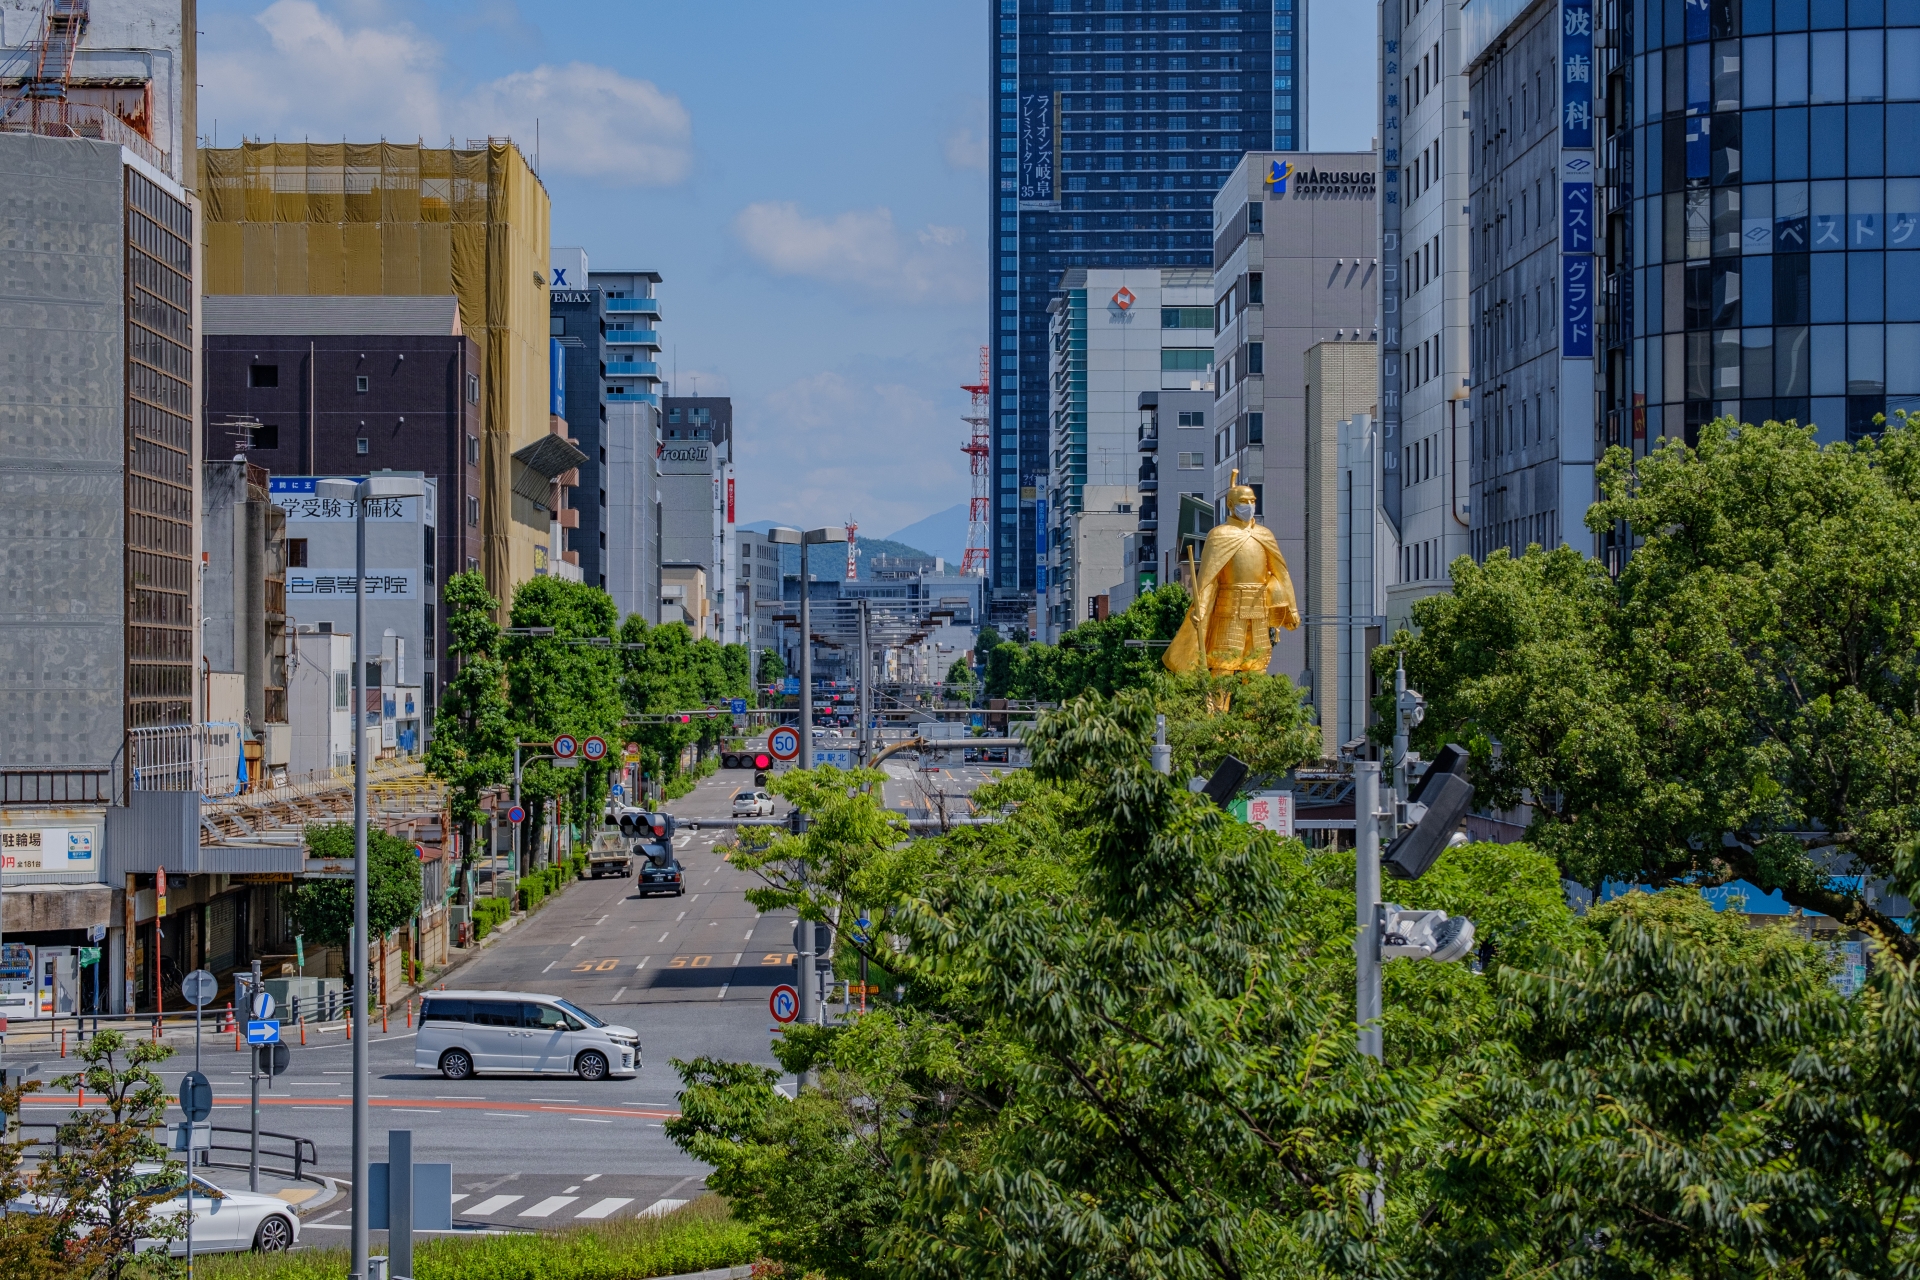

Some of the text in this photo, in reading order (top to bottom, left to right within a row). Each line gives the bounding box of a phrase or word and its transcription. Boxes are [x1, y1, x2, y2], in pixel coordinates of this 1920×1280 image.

[1565, 7, 1591, 130] 波歯科
[1035, 95, 1053, 197] ライオンズ岐阜
[1296, 166, 1376, 184] MARUSUGI
[1296, 185, 1376, 194] CORPORATION
[273, 498, 403, 518] 学受験予備校
[587, 742, 602, 754] 50
[775, 736, 795, 752] 50
[812, 753, 847, 762] 阜駅北
[2, 833, 41, 847] 駐輪場
[571, 959, 620, 972] 50
[667, 956, 713, 968] 50
